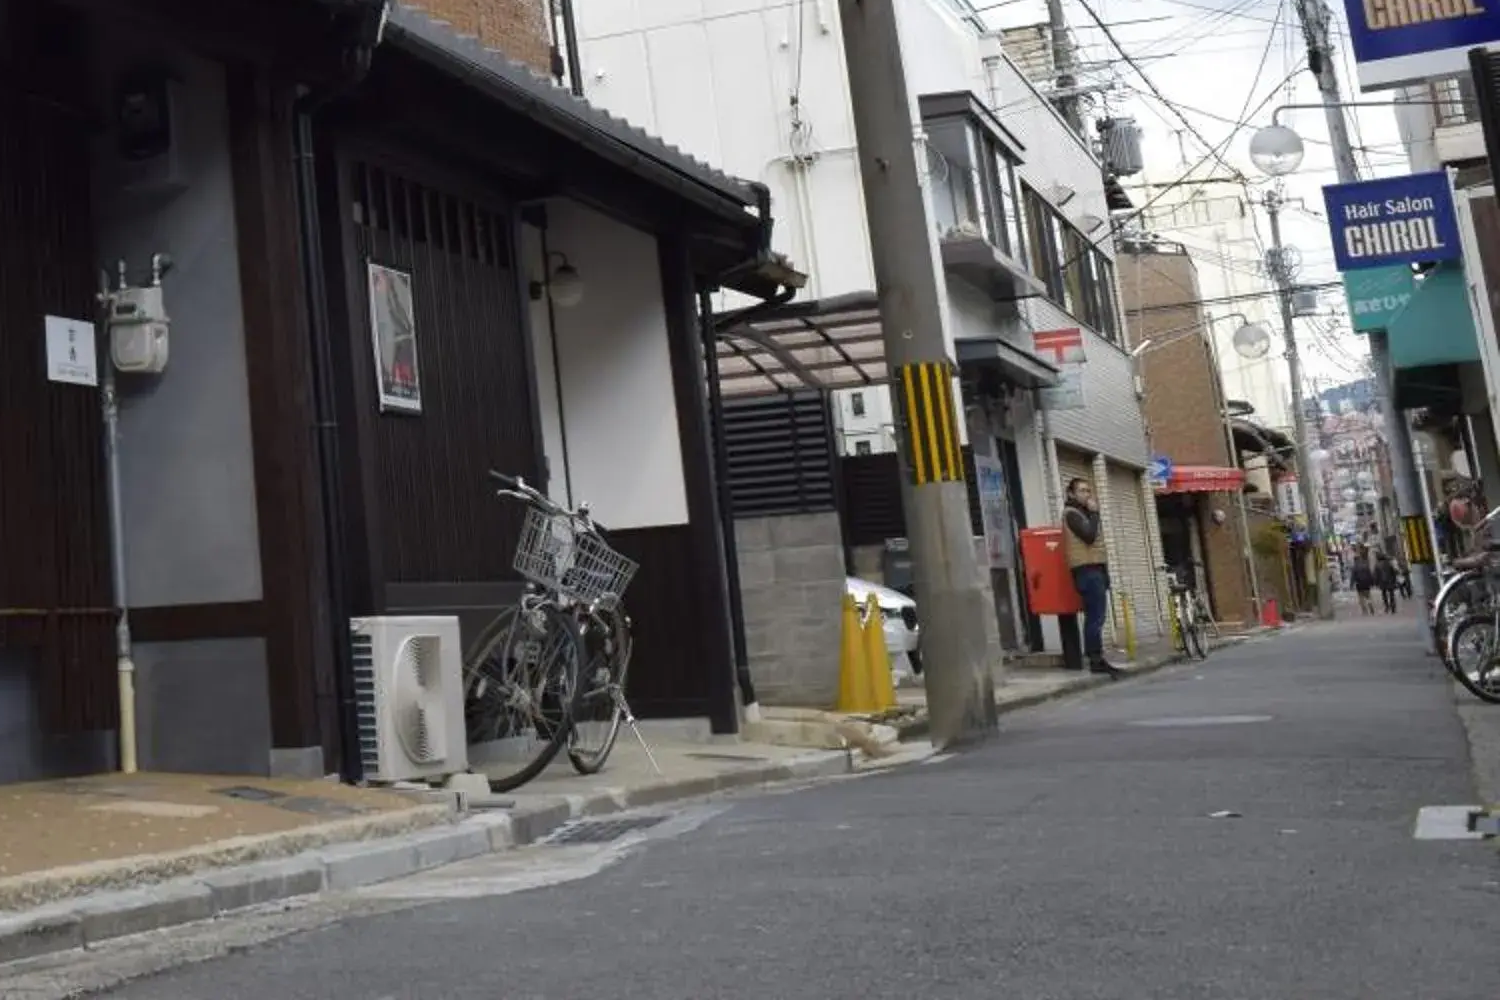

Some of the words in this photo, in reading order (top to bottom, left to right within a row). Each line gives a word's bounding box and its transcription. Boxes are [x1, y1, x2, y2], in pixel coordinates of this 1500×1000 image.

[1344, 201, 1381, 220] Hair
[1385, 196, 1434, 215] Salon
[1344, 216, 1445, 258] CHIROL
